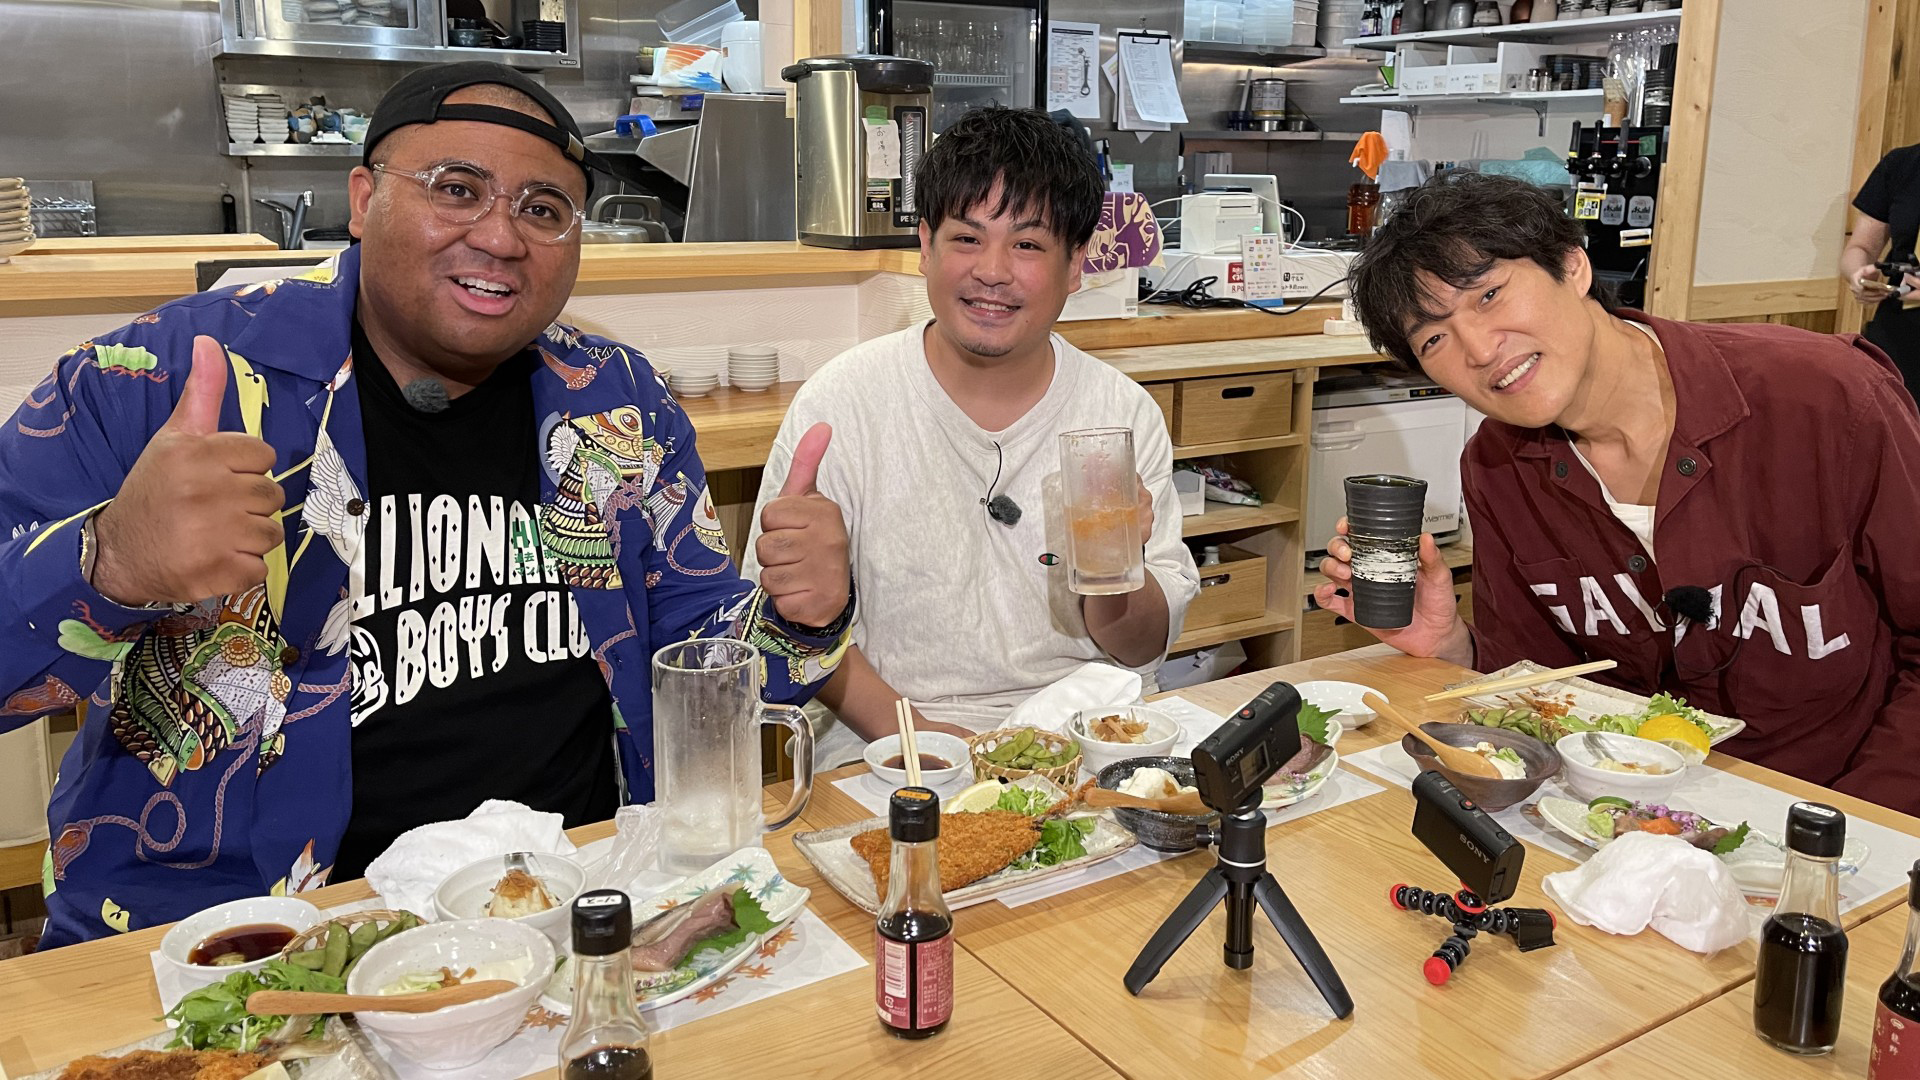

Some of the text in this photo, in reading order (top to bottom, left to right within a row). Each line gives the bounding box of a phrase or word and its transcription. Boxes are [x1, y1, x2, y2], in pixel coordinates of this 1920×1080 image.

[395, 591, 596, 705] BOYS CLU
[1225, 747, 1244, 767] SONY
[1460, 833, 1490, 863] SONY
